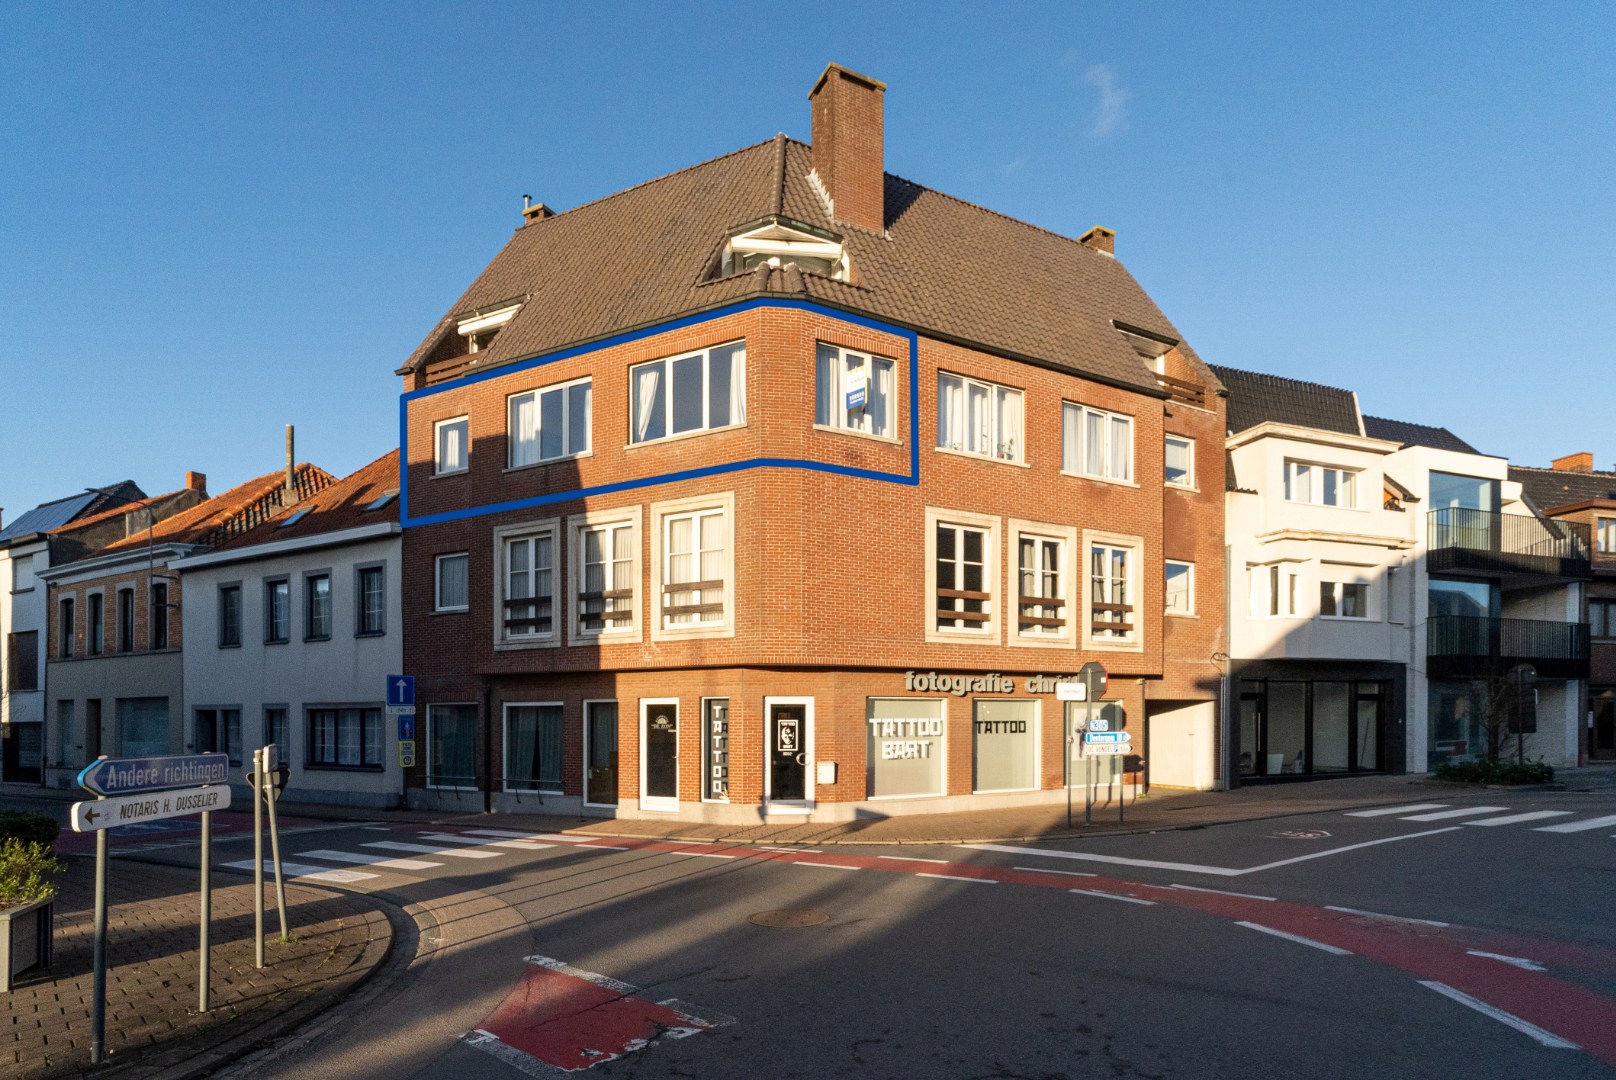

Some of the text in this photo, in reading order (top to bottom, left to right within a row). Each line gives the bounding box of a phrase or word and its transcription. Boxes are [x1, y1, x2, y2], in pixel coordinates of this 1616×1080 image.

[904, 671, 1014, 696] fotografie
[869, 718, 942, 736] TATTOO
[976, 721, 1026, 734] TATTOO
[713, 706, 722, 793] TATTOO
[106, 760, 224, 789] Andere richtingen
[120, 792, 218, 819] NOTARIS H. DUSSELIER
